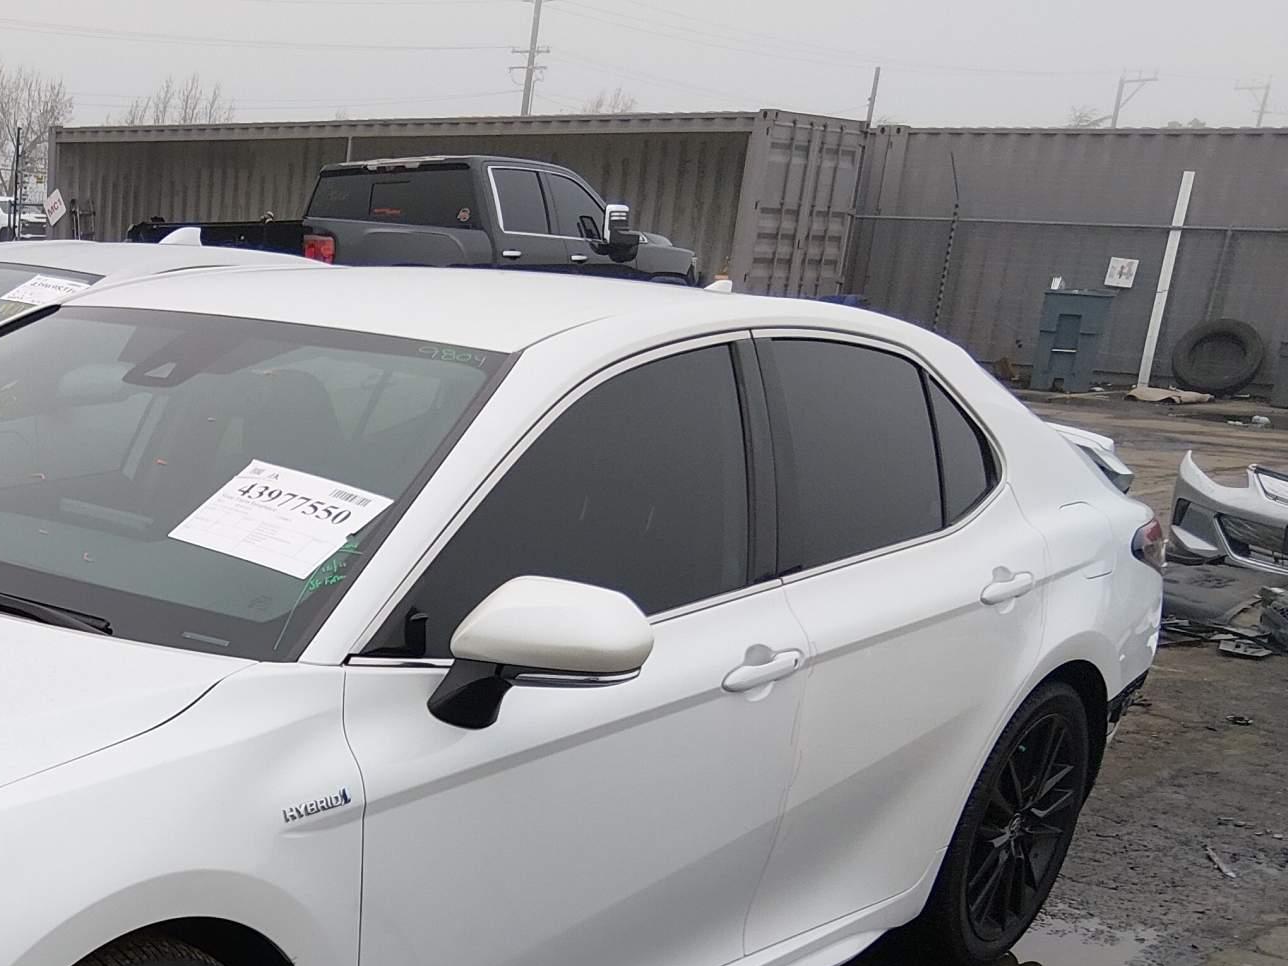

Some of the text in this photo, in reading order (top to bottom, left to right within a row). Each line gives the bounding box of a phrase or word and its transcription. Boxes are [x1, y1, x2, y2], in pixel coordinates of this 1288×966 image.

[418, 345, 486, 367] 9804
[237, 482, 352, 525] 43977550
[281, 794, 342, 823] HYBRID
